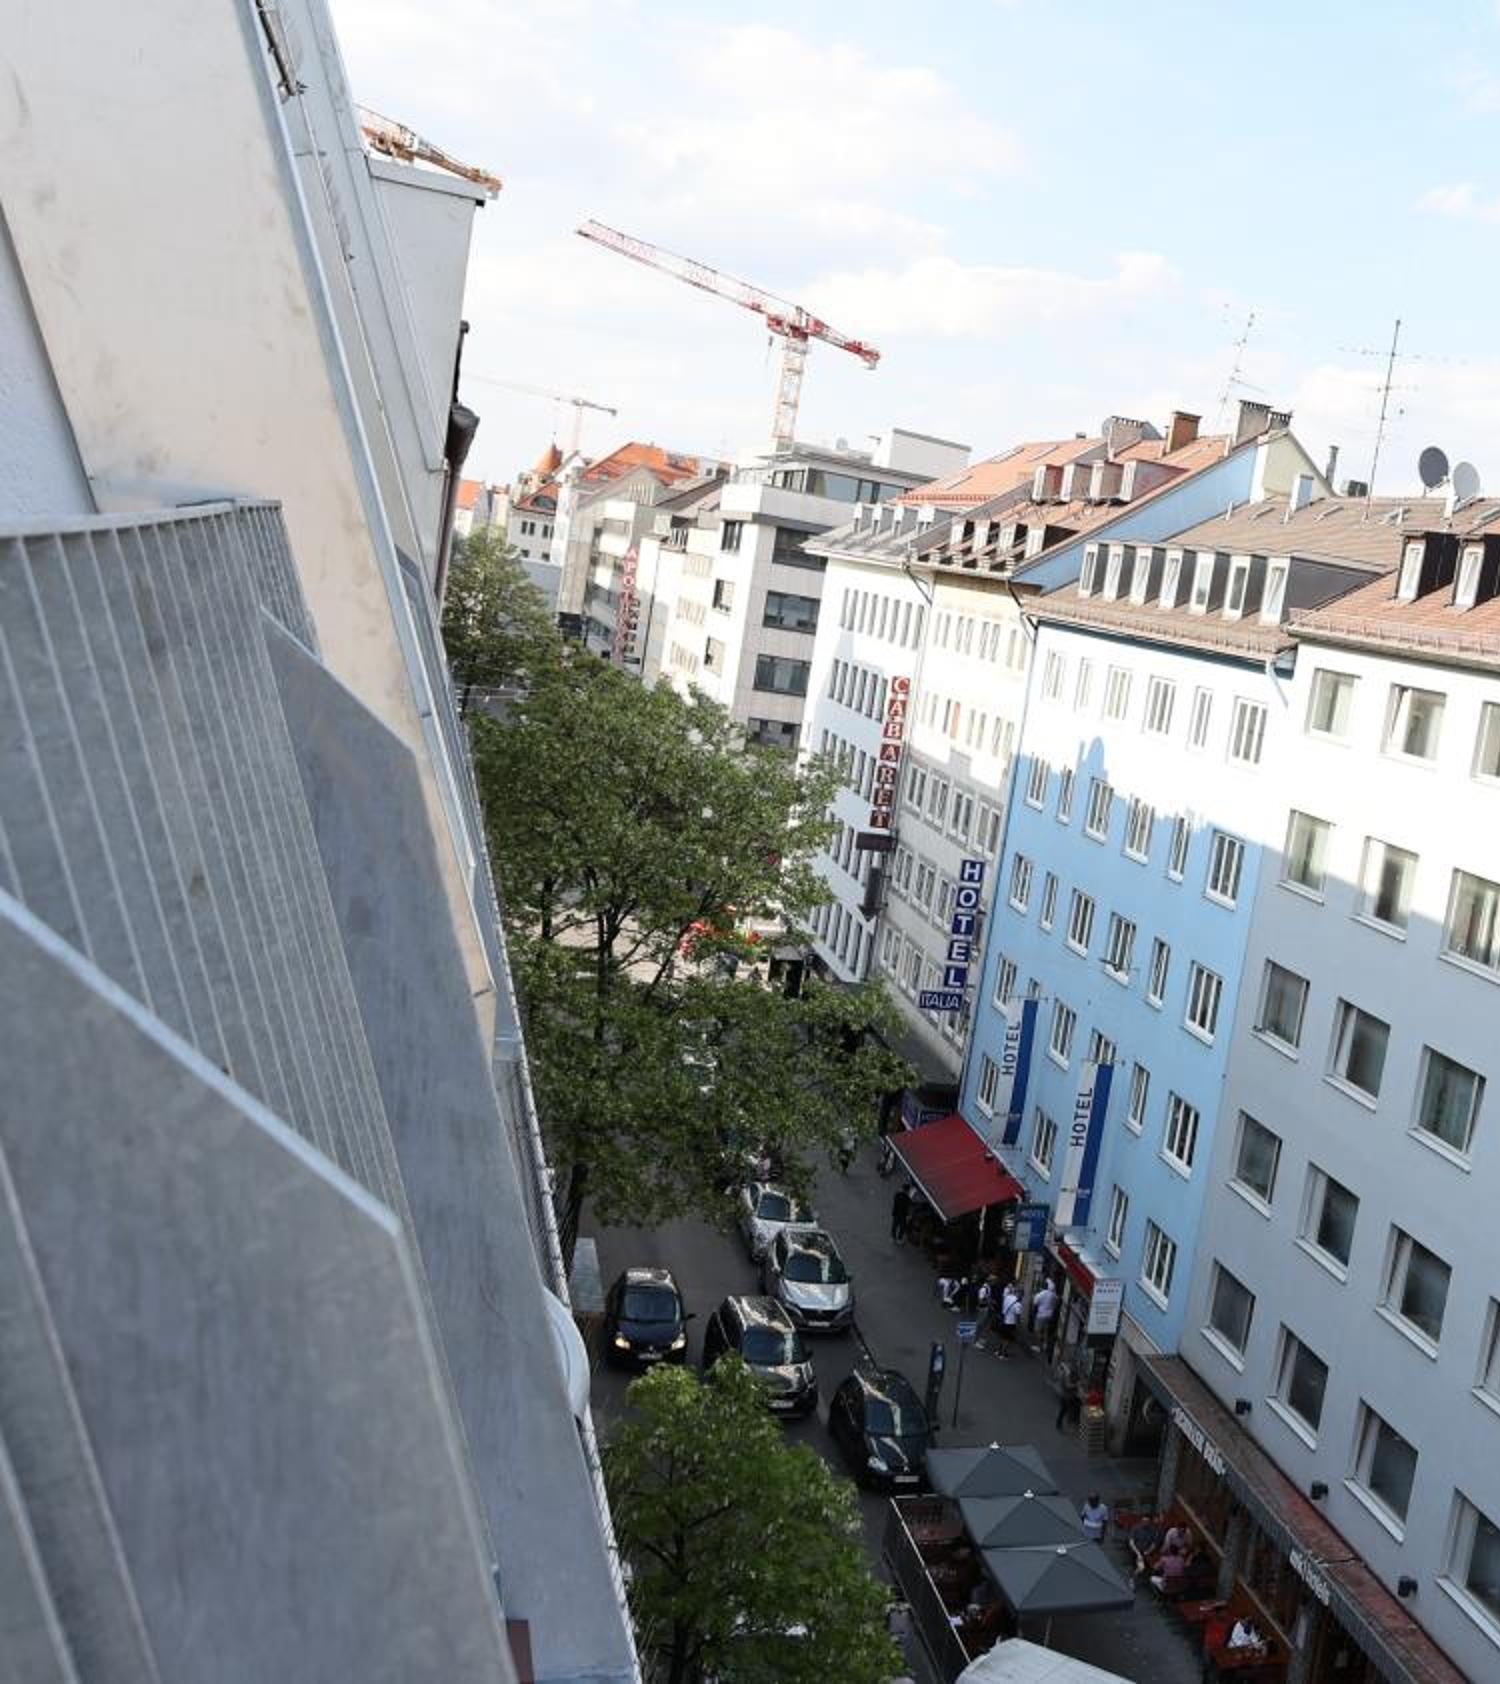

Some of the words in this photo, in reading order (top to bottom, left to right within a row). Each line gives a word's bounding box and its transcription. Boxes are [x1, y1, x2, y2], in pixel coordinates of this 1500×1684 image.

[872, 677, 909, 827] CABARET
[947, 863, 982, 986] HOTEL
[920, 993, 960, 1010] ITALIA
[1002, 1021, 1021, 1076] HOTEL
[1070, 1087, 1093, 1147] HOTEL
